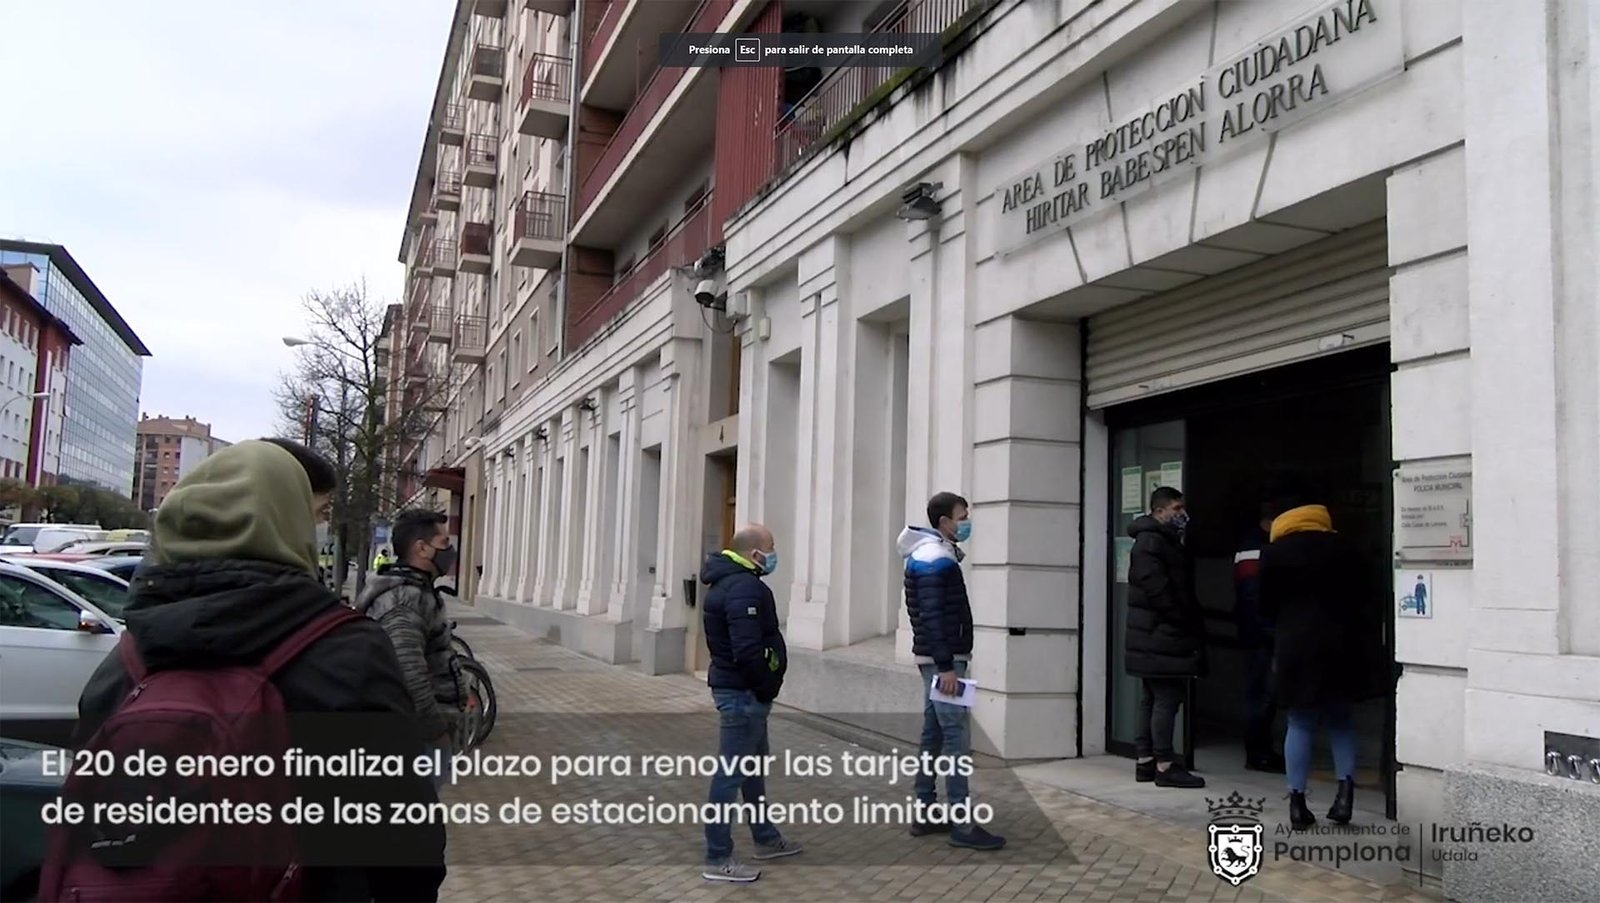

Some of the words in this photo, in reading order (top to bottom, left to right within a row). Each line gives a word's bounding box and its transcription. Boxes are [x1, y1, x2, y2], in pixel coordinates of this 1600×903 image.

[1001, 177, 1043, 215] AREA
[1053, 155, 1077, 189] DE
[1085, 81, 1206, 173] PROTECCION
[1218, 0, 1378, 99] CIUDADANA
[1025, 188, 1091, 235] HIRITAR
[1099, 122, 1206, 200] BABESPEN
[1218, 63, 1329, 144] ALORRA
